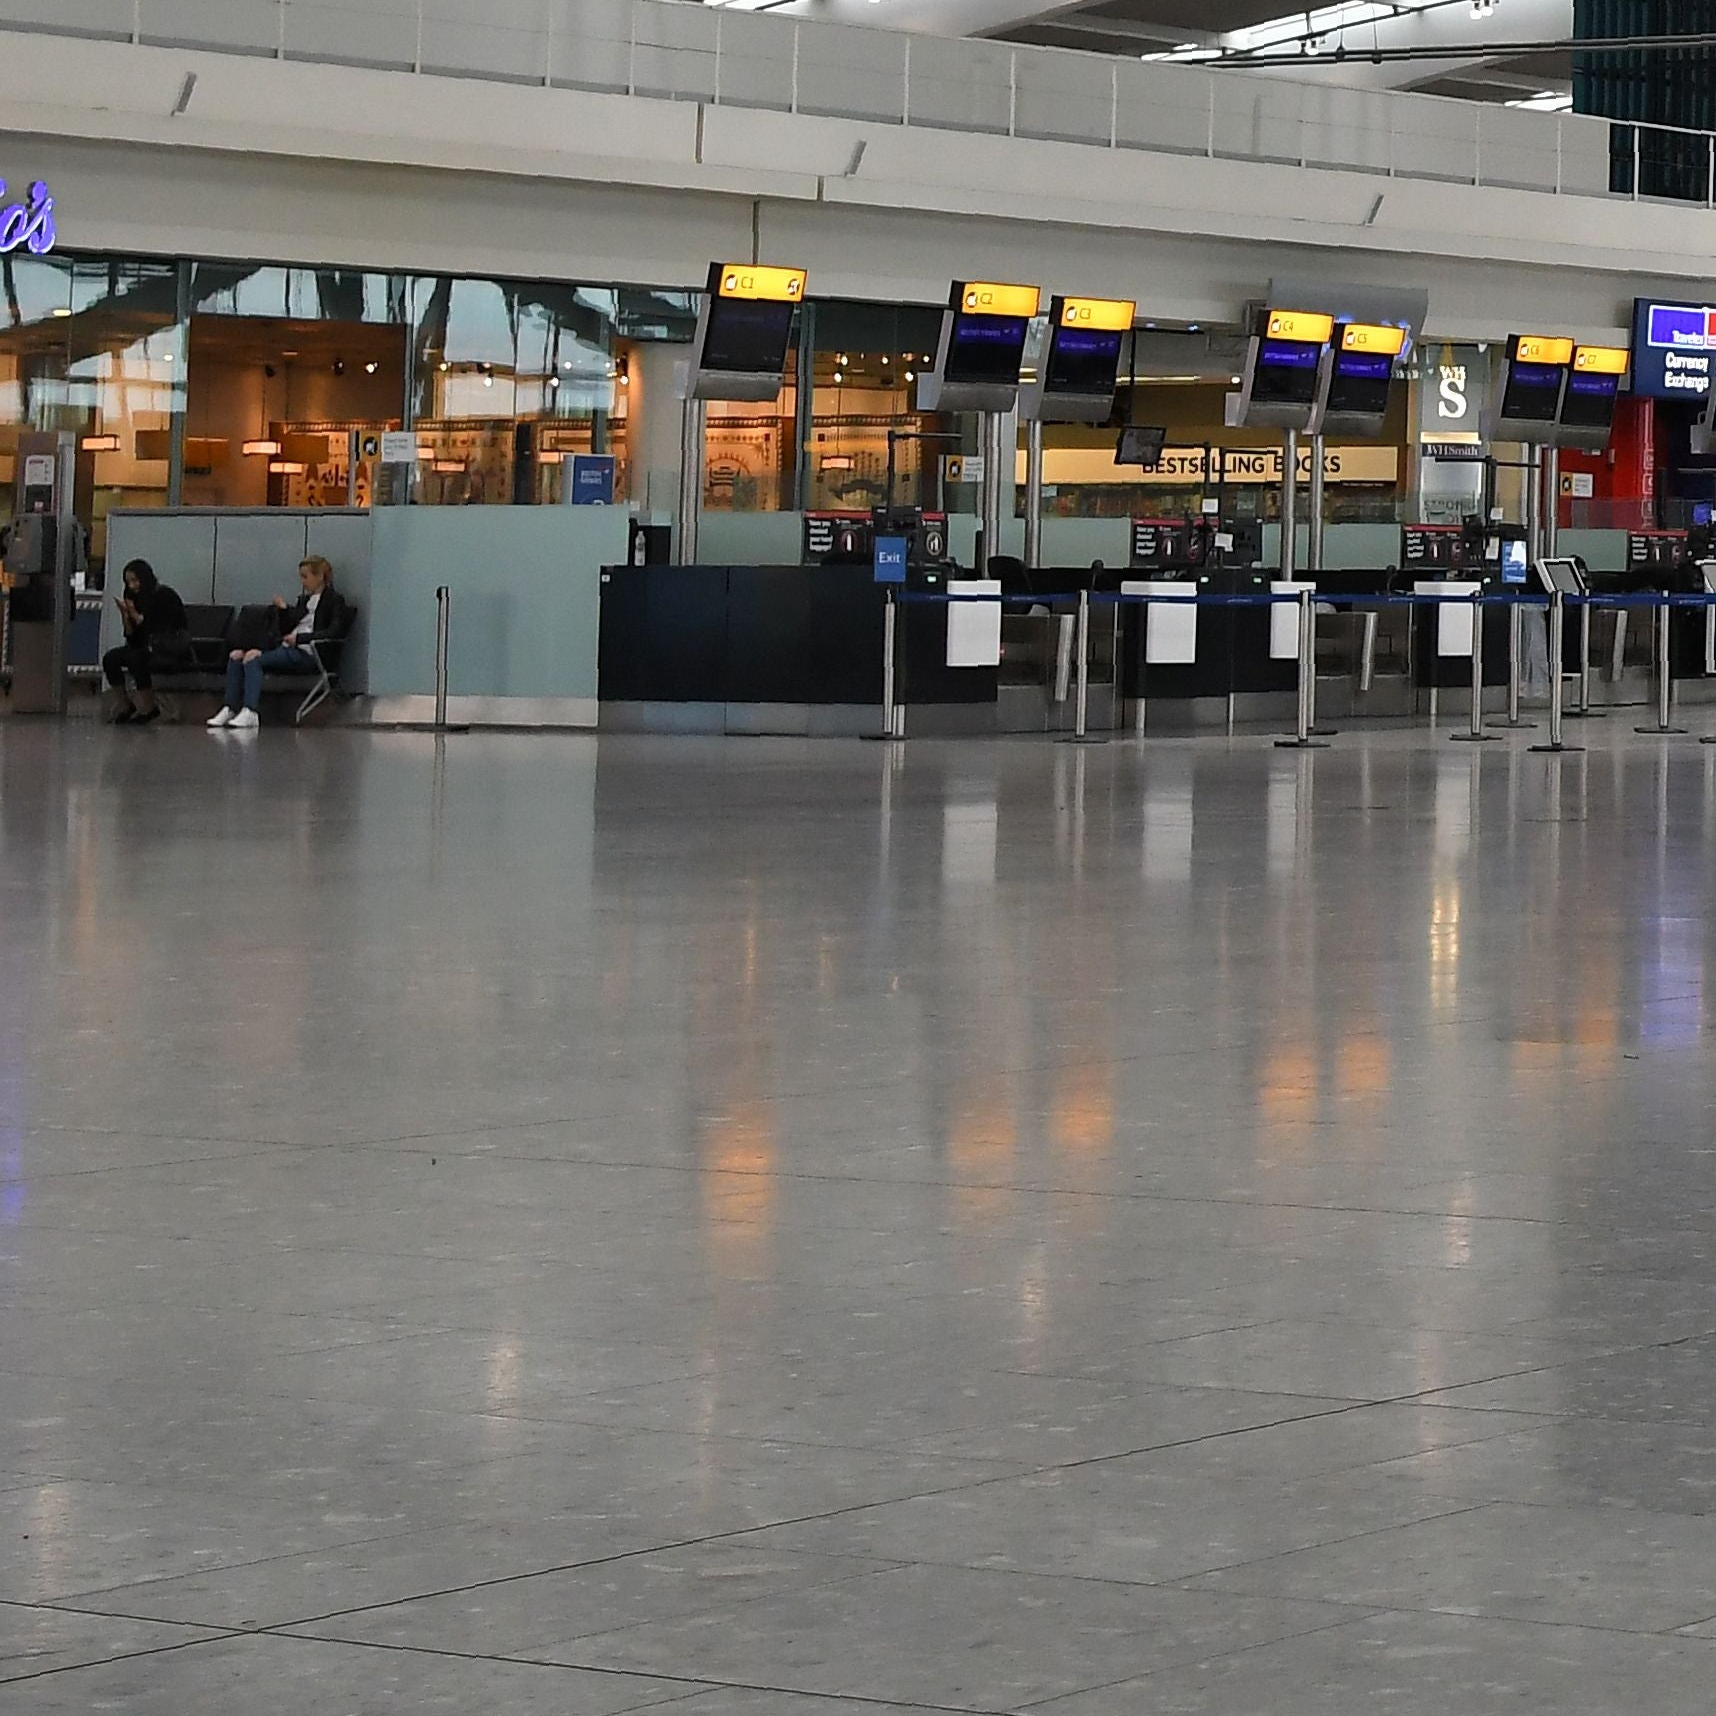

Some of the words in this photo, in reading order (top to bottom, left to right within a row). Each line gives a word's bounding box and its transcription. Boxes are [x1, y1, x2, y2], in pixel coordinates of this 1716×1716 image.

[740, 276, 754, 290] C1
[1666, 351, 1709, 373] Currency
[1665, 371, 1709, 393] Exchange
[1439, 378, 1467, 418] S
[1426, 444, 1479, 456] WHSmith
[879, 551, 901, 563] Exit
